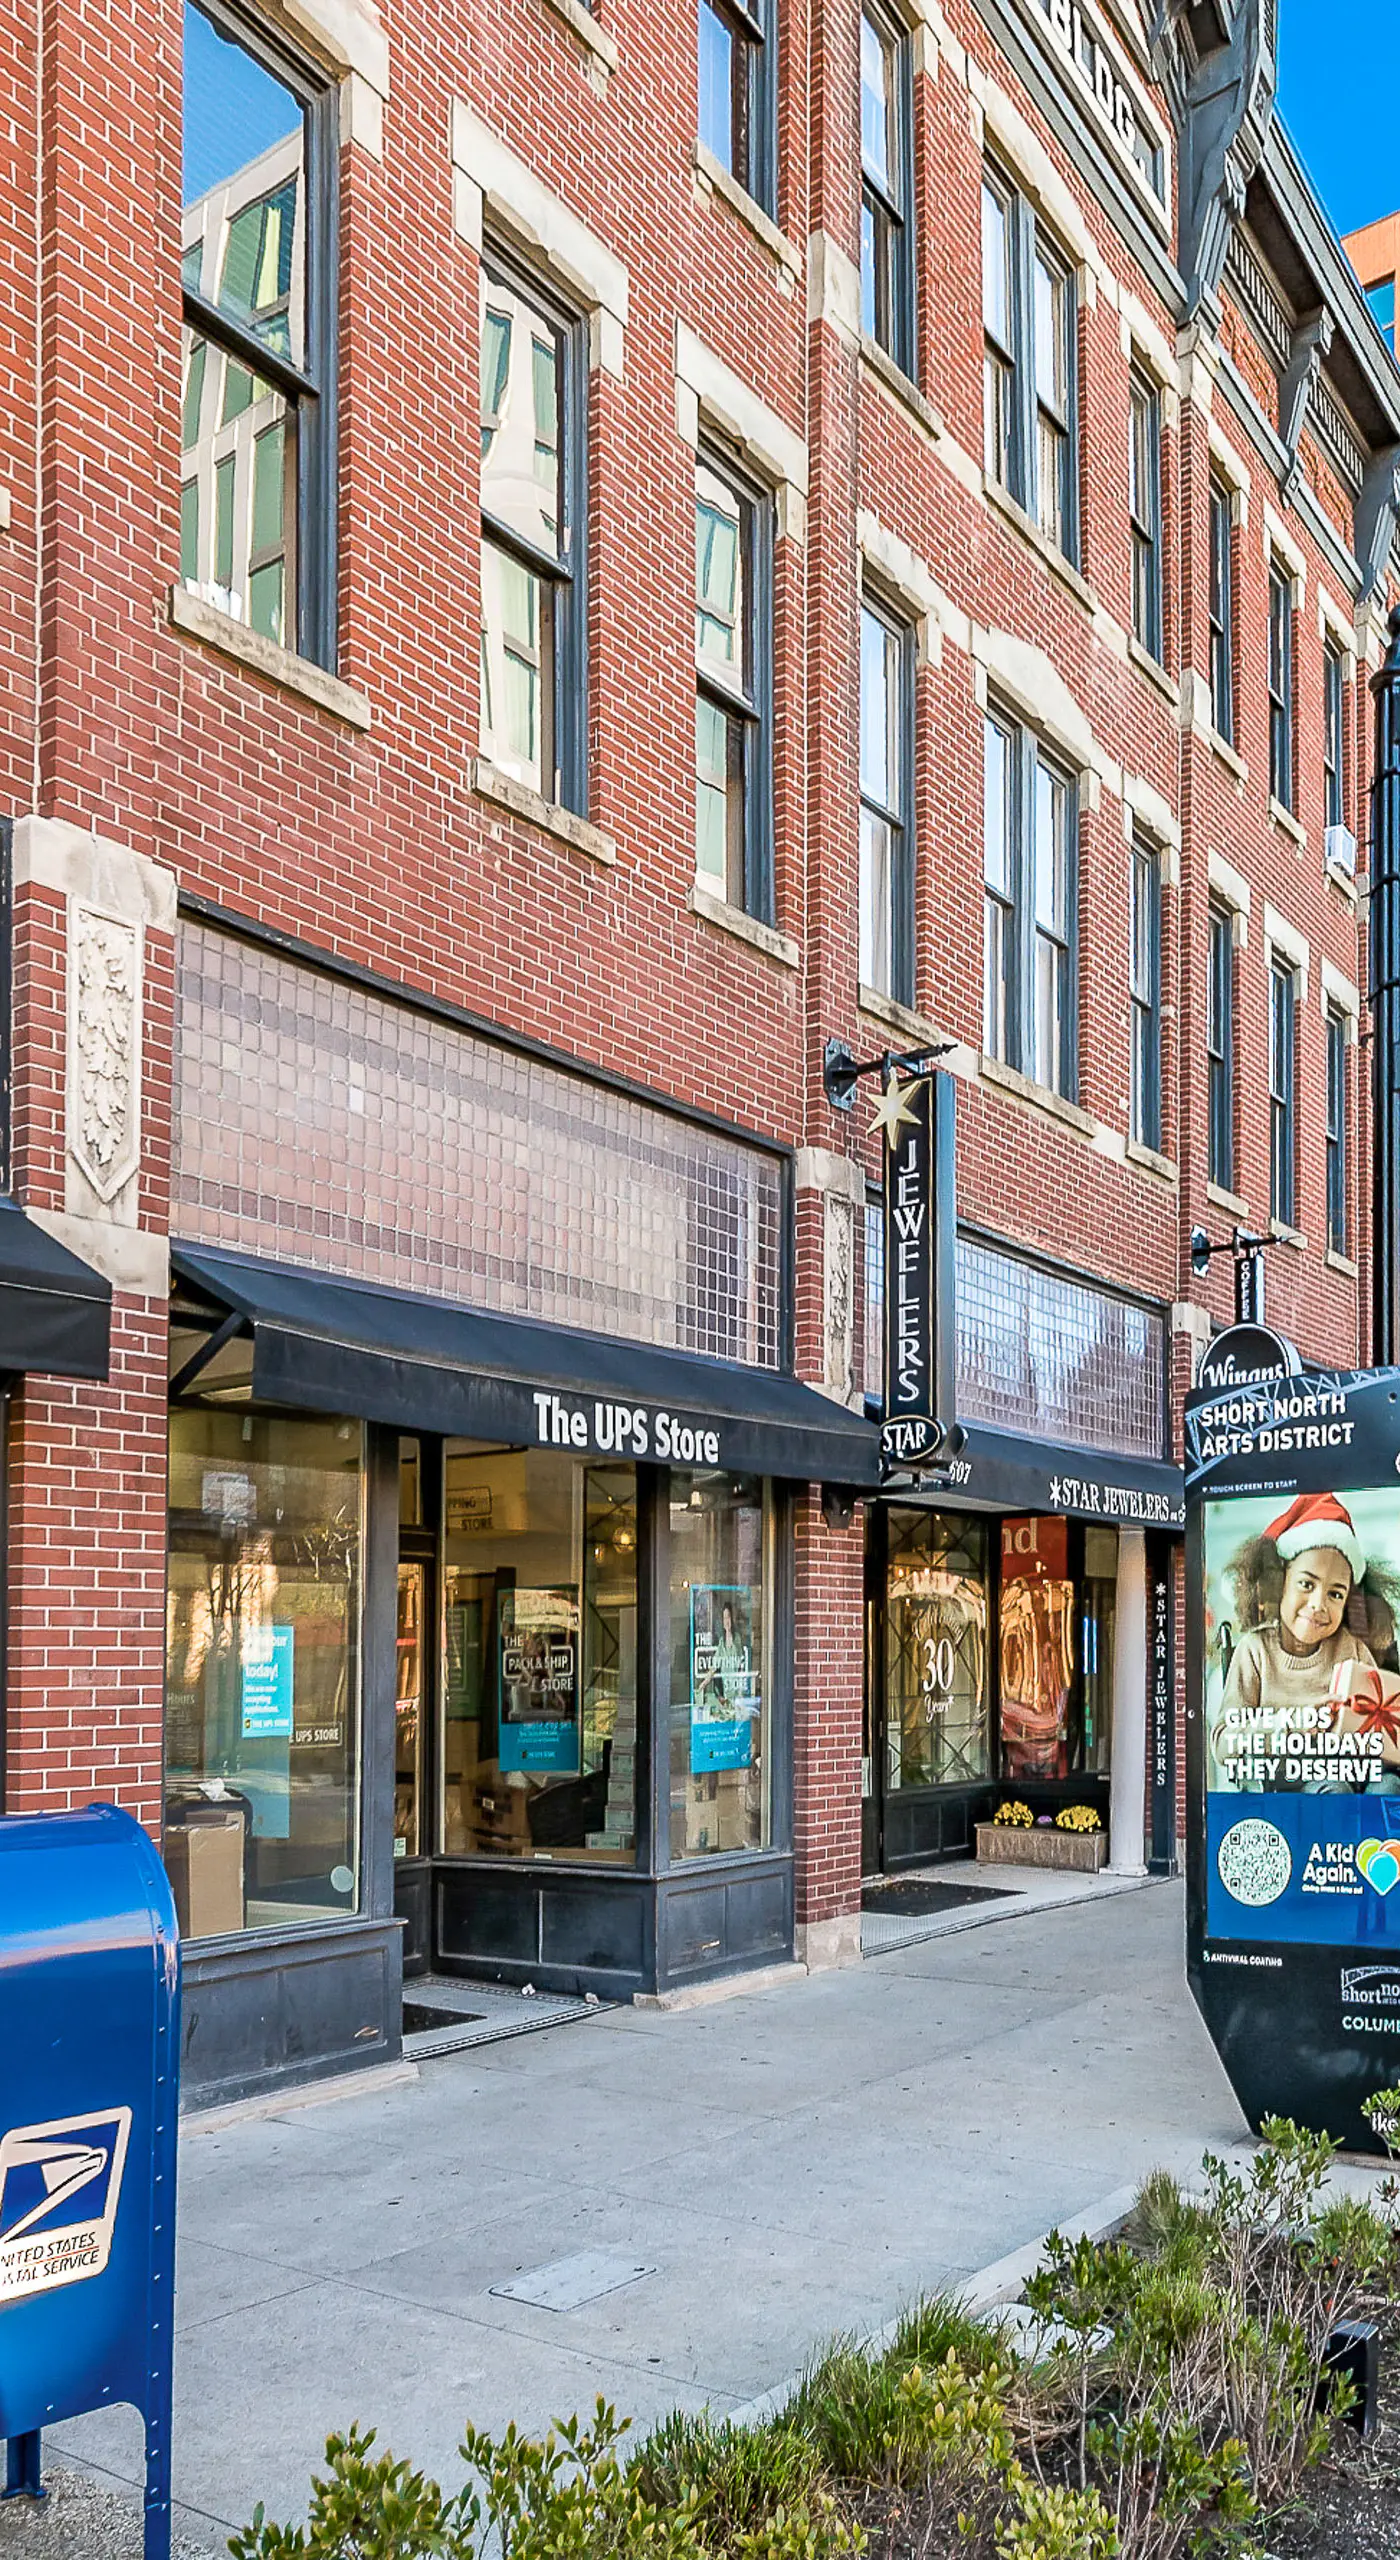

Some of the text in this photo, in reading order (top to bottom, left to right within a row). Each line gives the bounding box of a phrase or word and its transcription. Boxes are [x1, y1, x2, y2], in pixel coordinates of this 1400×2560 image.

[893, 1139, 926, 1402] JEWELERS
[1240, 1261, 1251, 1320] COFFEE
[1203, 1354, 1284, 1388] Winans
[1201, 1391, 1346, 1428] SHORT NORTH
[533, 1392, 719, 1464] The UPS Store
[882, 1422, 926, 1452] STAR
[1201, 1422, 1355, 1458] ARTS DISTRICT
[949, 1460, 972, 1485] 607
[1062, 1477, 1101, 1513] STAR
[1102, 1485, 1169, 1522] JEWELERS
[504, 1635, 523, 1648] THE
[246, 1663, 279, 1682] today!
[923, 1637, 954, 1692] 30
[541, 1677, 574, 1691] STORE
[1154, 1599, 1168, 1787] STAR JEWELERS
[1225, 1707, 1332, 1729] GIVE KIDS
[295, 1730, 313, 1743] UPS
[314, 1727, 340, 1742] STORE
[1224, 1732, 1384, 1756] THE HOLIDAYS
[1224, 1758, 1383, 1782] THEY DESERVE
[1308, 1842, 1354, 1863] A Kid
[1341, 1985, 1381, 2004] short
[1, 2231, 96, 2268] NITED STATES
[43, 2248, 100, 2277] SERVICE
